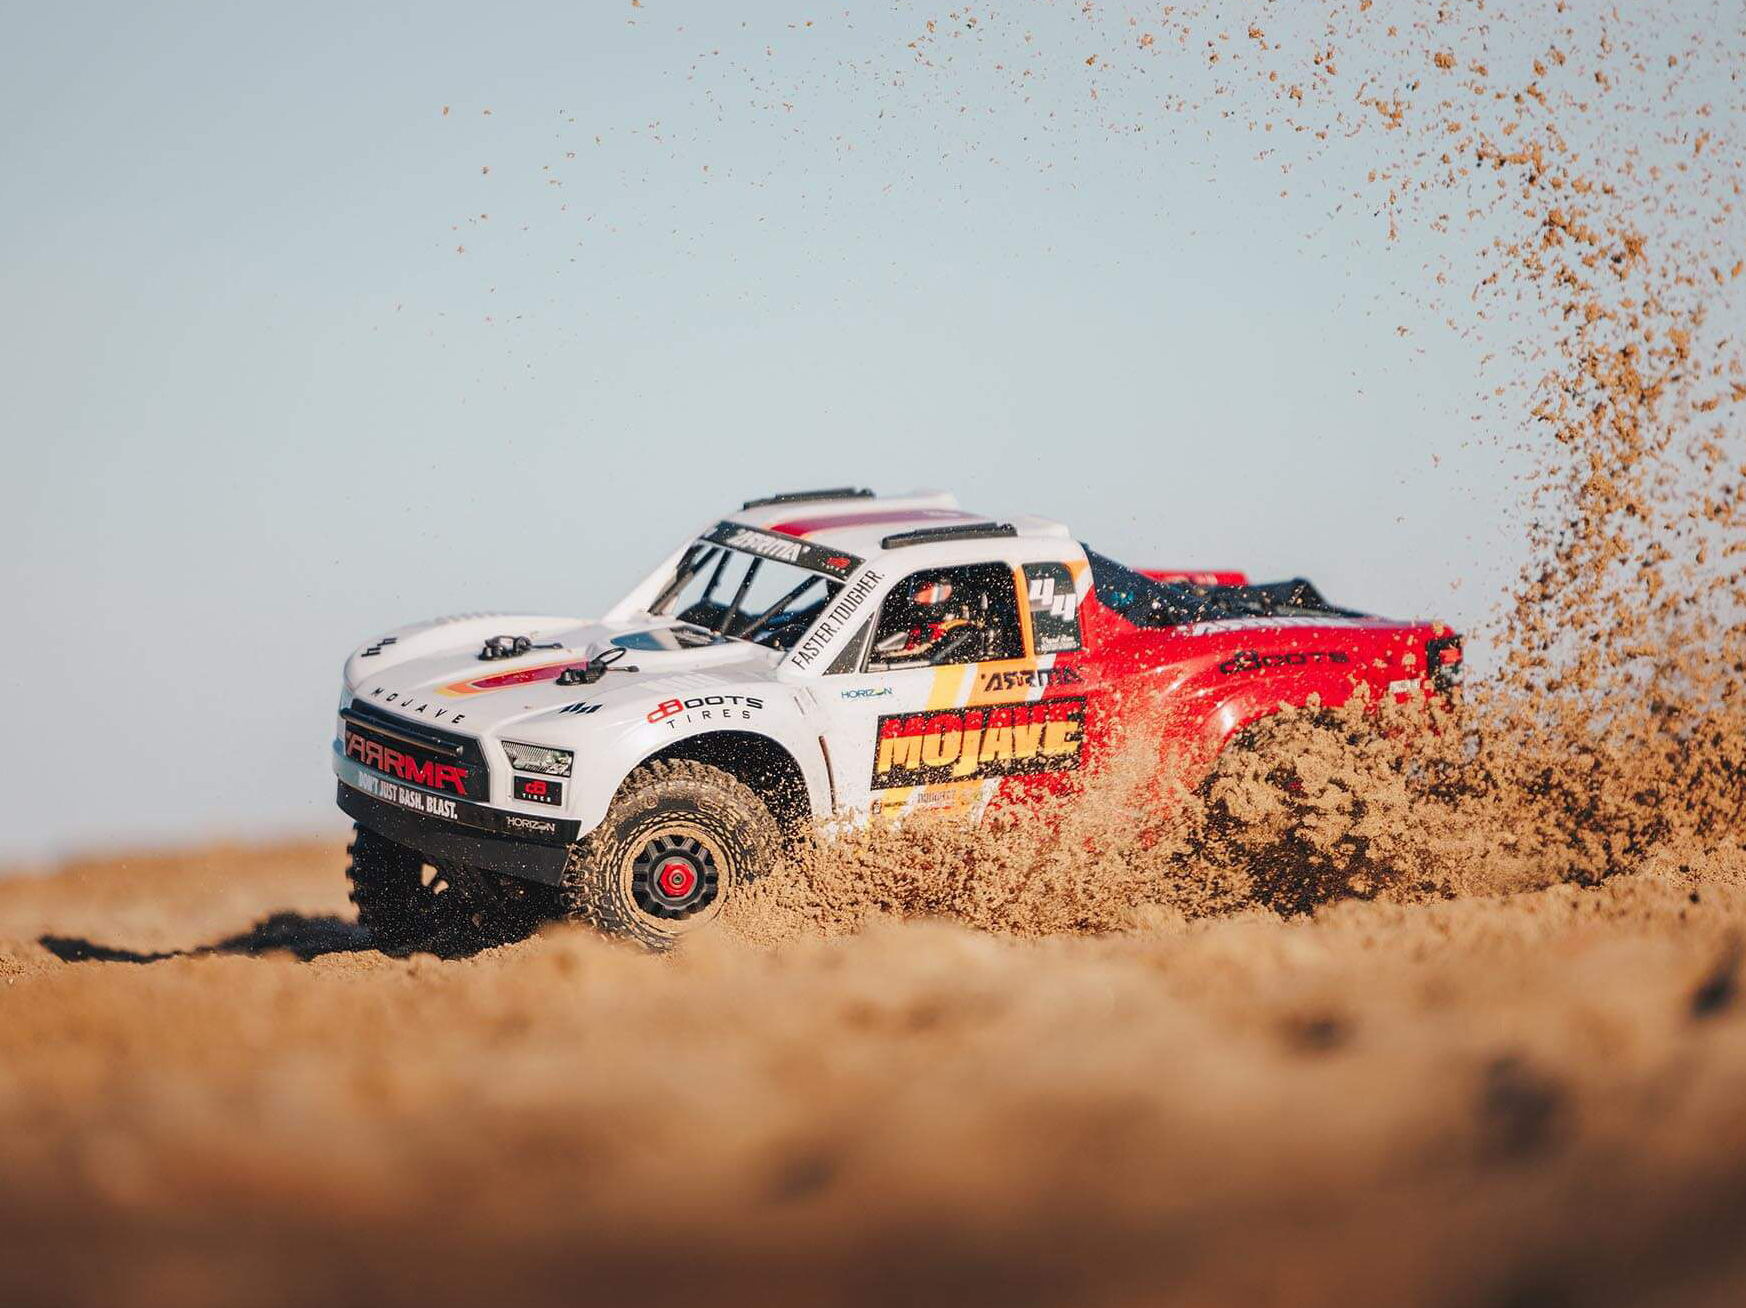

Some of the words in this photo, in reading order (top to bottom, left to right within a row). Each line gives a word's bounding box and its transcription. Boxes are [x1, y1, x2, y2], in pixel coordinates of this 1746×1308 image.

[791, 622, 840, 670] FASTER.
[828, 569, 885, 625] TOUGHER.
[1028, 577, 1076, 621] 44
[370, 686, 466, 725] MOJAVE
[666, 709, 751, 729] TIRES
[876, 701, 1083, 777] MOJAVE
[345, 730, 467, 797] ARRMA
[379, 780, 398, 802] JUST
[398, 786, 425, 811] BASH.
[426, 795, 459, 820] BLAST.
